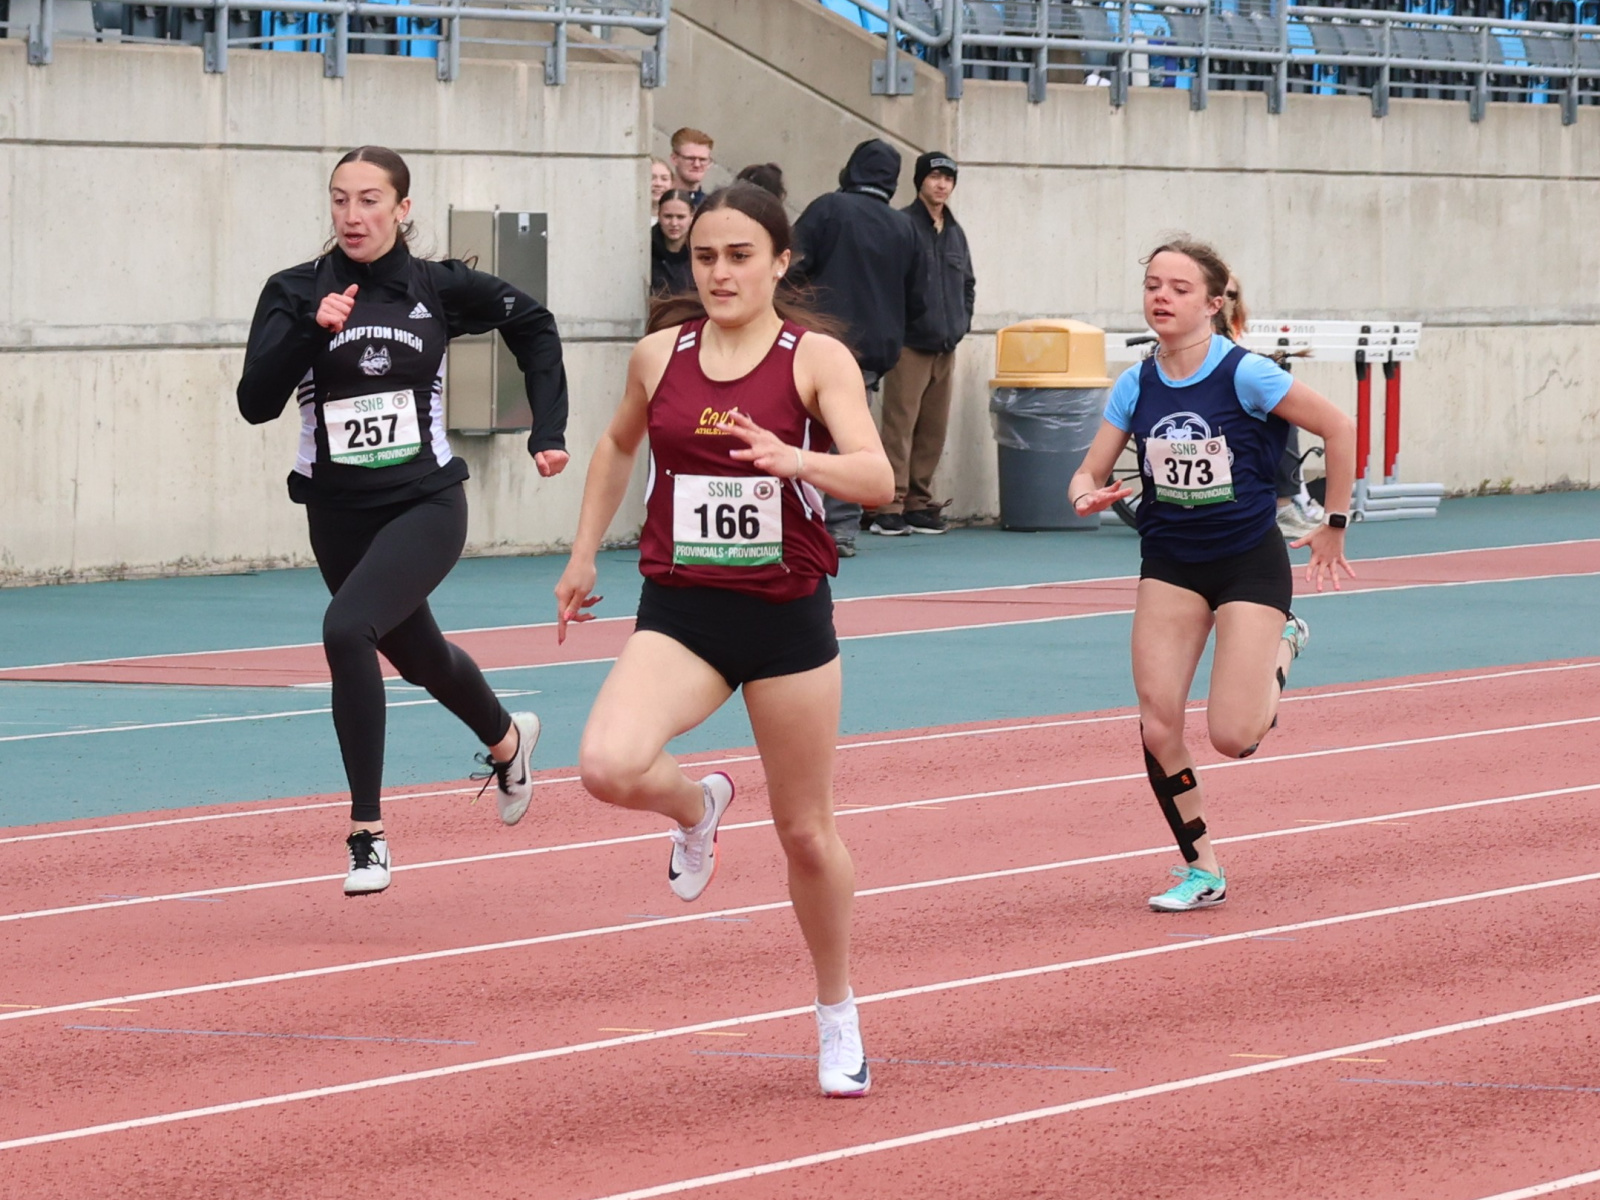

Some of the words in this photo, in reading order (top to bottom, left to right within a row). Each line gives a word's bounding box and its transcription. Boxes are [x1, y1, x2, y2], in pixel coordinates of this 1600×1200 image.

[329, 325, 392, 352] HAMPTON
[393, 327, 423, 353] HIGH
[354, 397, 384, 414] SSNB
[344, 413, 399, 449] 257
[694, 427, 732, 436] ATHLET
[1170, 442, 1198, 456] SSNB
[1164, 457, 1214, 486] 373
[708, 481, 743, 498] SSNB
[694, 503, 761, 540] 166
[675, 544, 724, 558] PROVINCIALS
[728, 545, 780, 558] PROVINCIAUX
